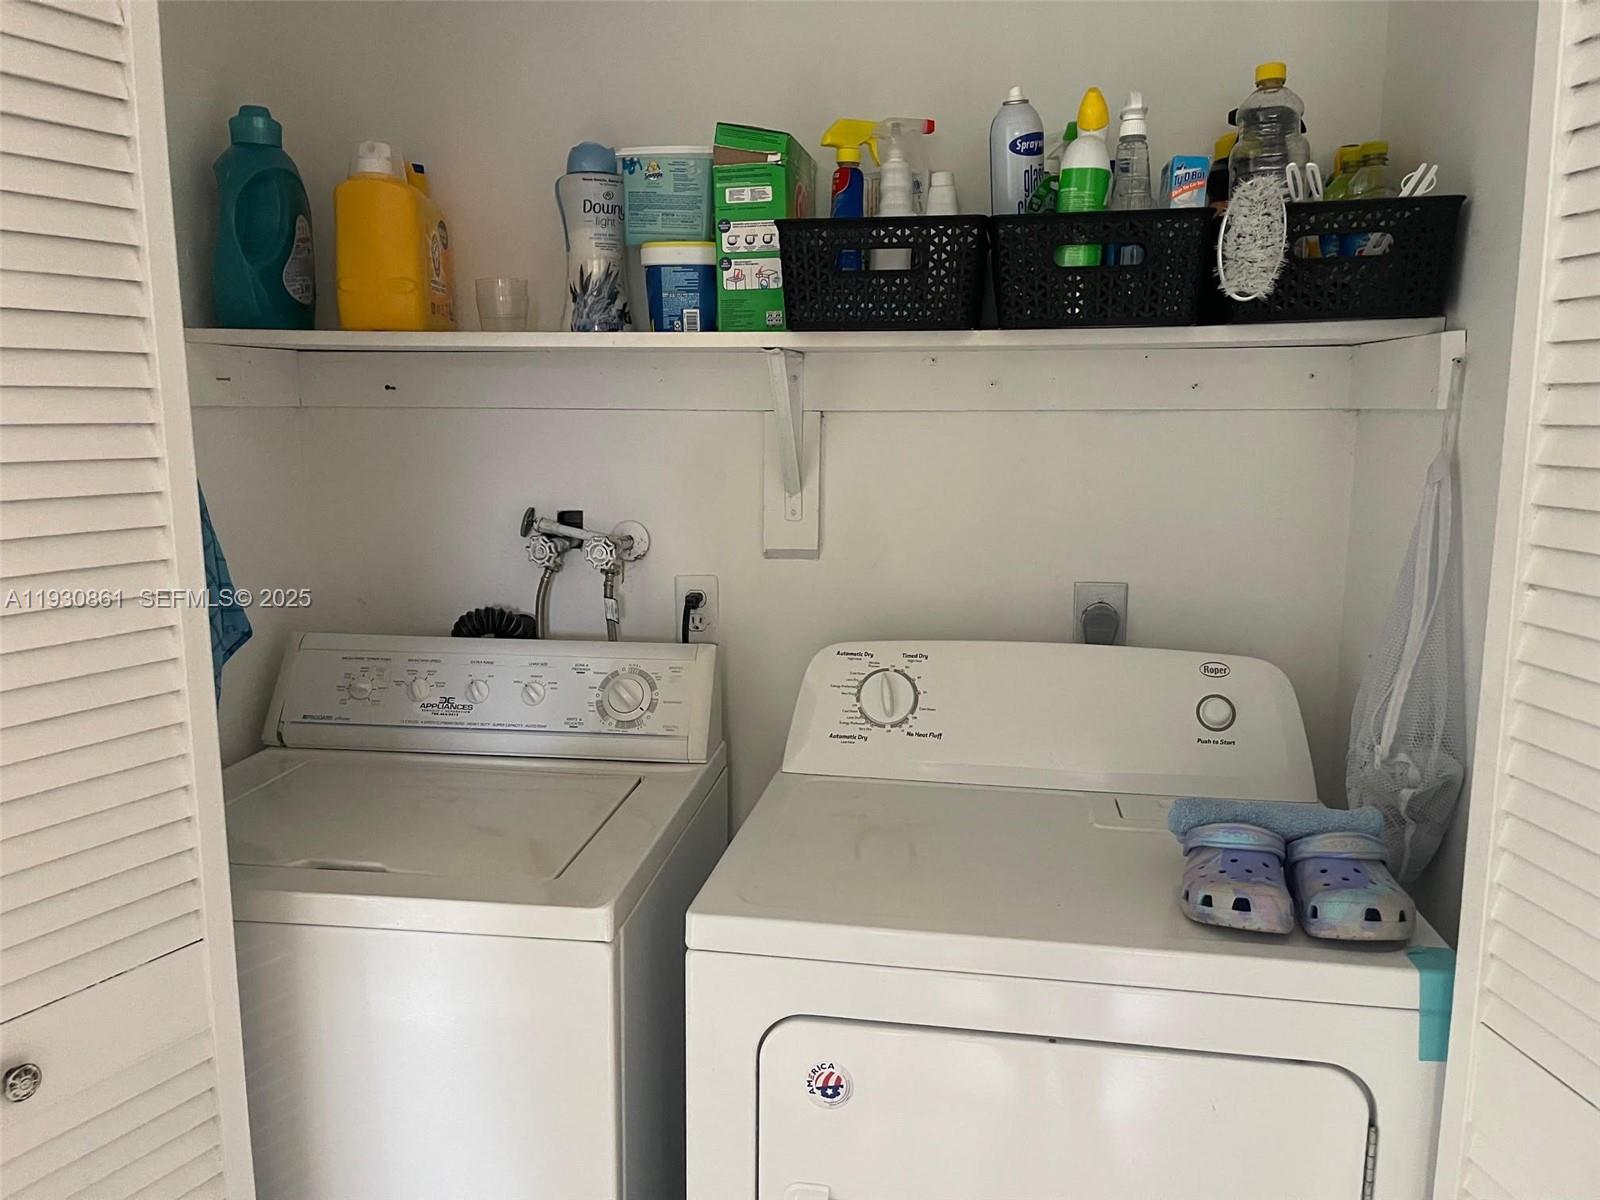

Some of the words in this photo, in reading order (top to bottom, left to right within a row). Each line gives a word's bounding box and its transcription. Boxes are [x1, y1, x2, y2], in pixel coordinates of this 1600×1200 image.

[583, 199, 624, 221] Downy
[595, 215, 615, 229] light
[1203, 665, 1227, 675] Roper
[420, 702, 474, 711] APPLIANCES
[806, 1063, 835, 1095] AMERICA
